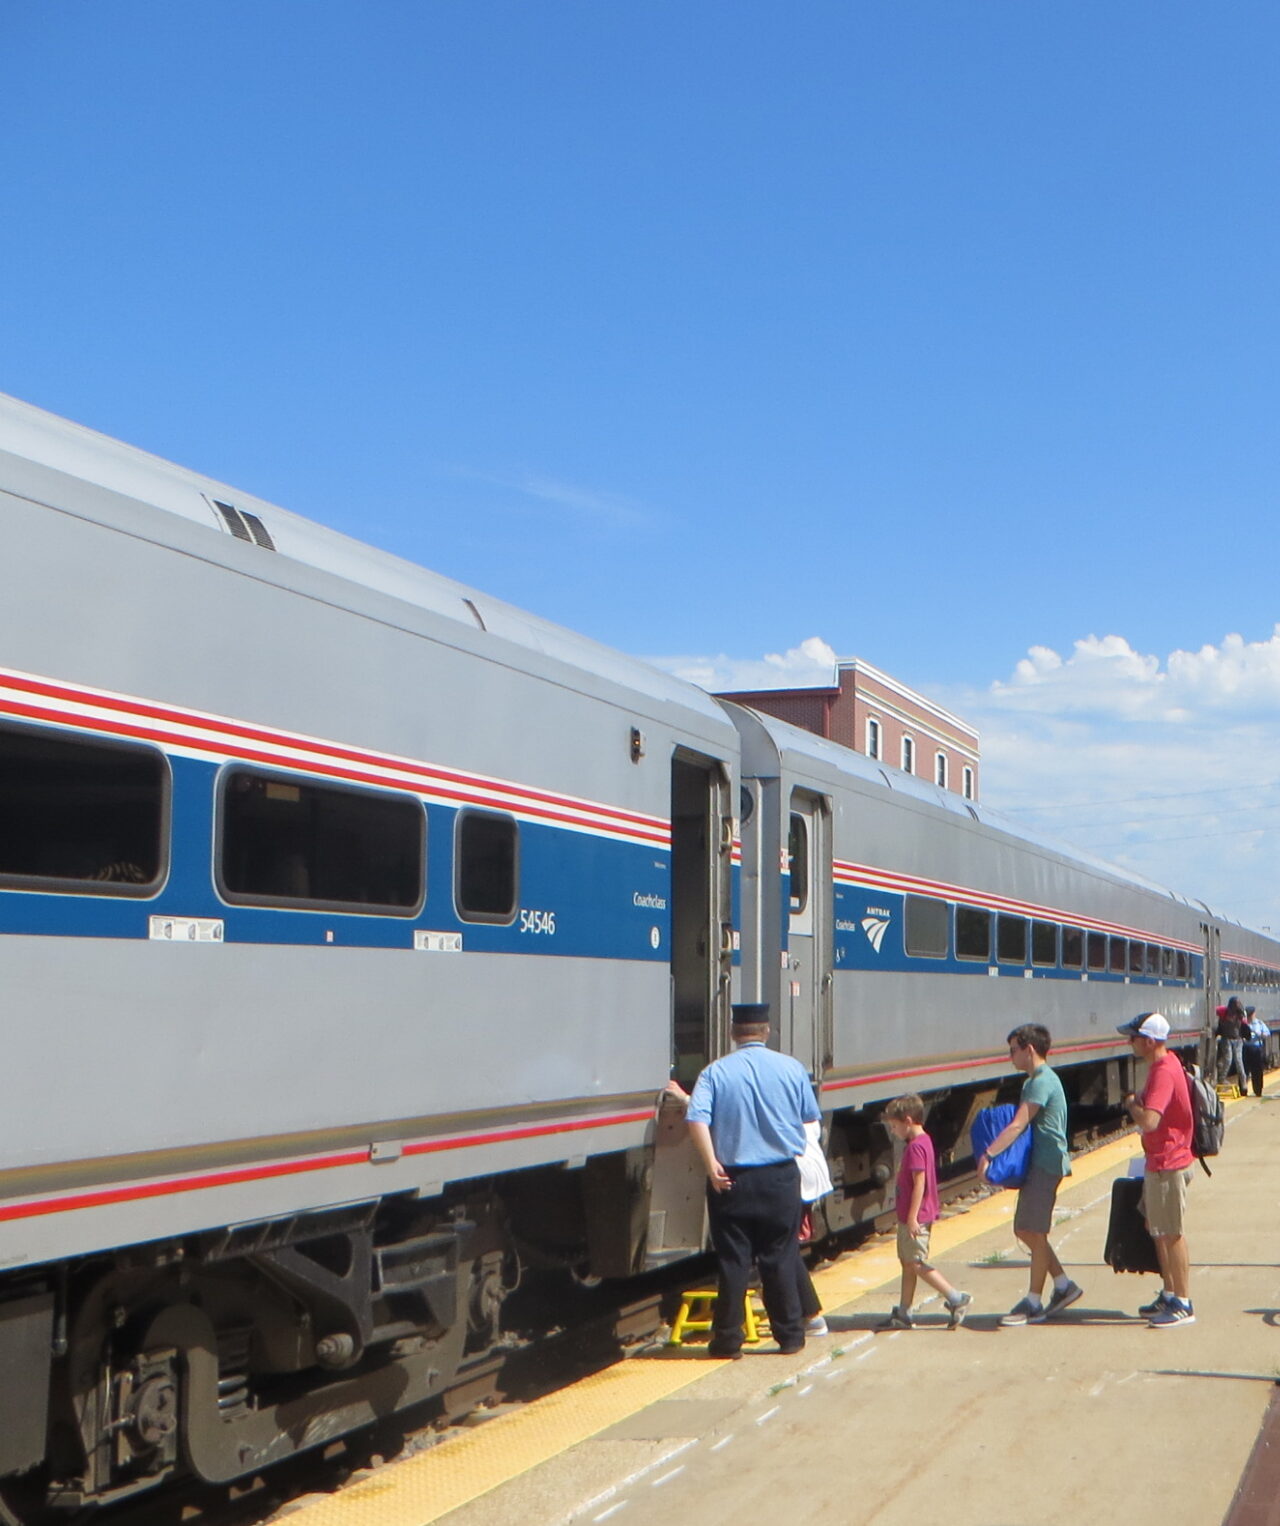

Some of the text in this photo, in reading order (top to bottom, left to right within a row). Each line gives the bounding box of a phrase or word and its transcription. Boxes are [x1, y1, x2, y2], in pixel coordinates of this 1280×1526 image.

[633, 891, 667, 910] Coachclass
[867, 906, 890, 917] AMTRAK
[520, 909, 556, 935] 54546
